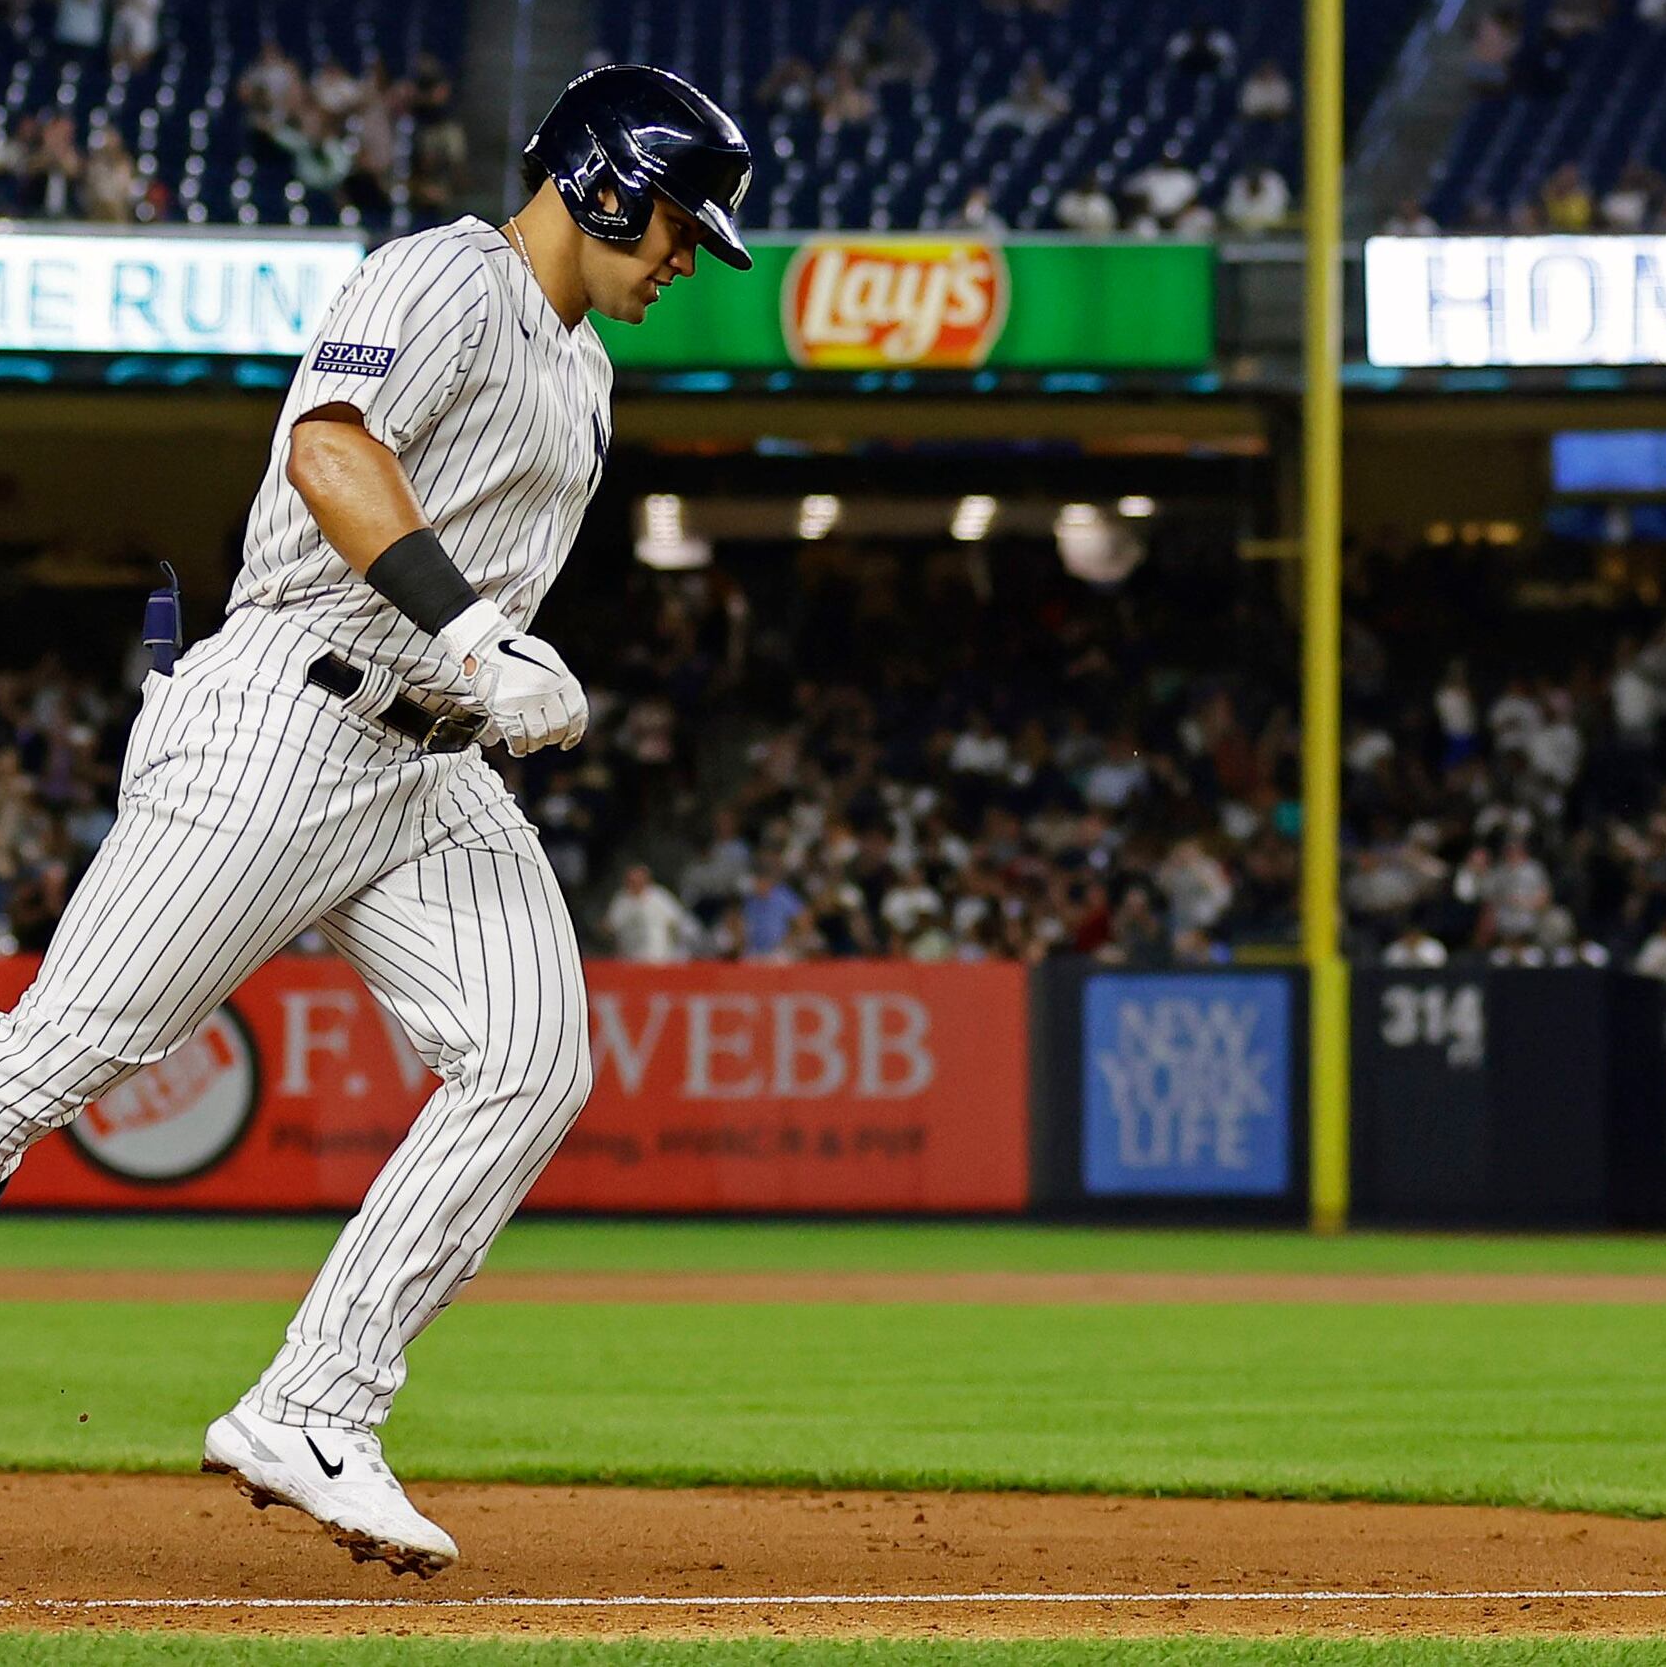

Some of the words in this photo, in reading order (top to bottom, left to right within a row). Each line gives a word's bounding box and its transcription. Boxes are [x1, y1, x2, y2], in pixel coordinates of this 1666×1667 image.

[108, 258, 319, 342] RUN
[801, 245, 990, 362] Lay's
[317, 363, 384, 375] INSURANCE
[320, 344, 389, 365] STARR
